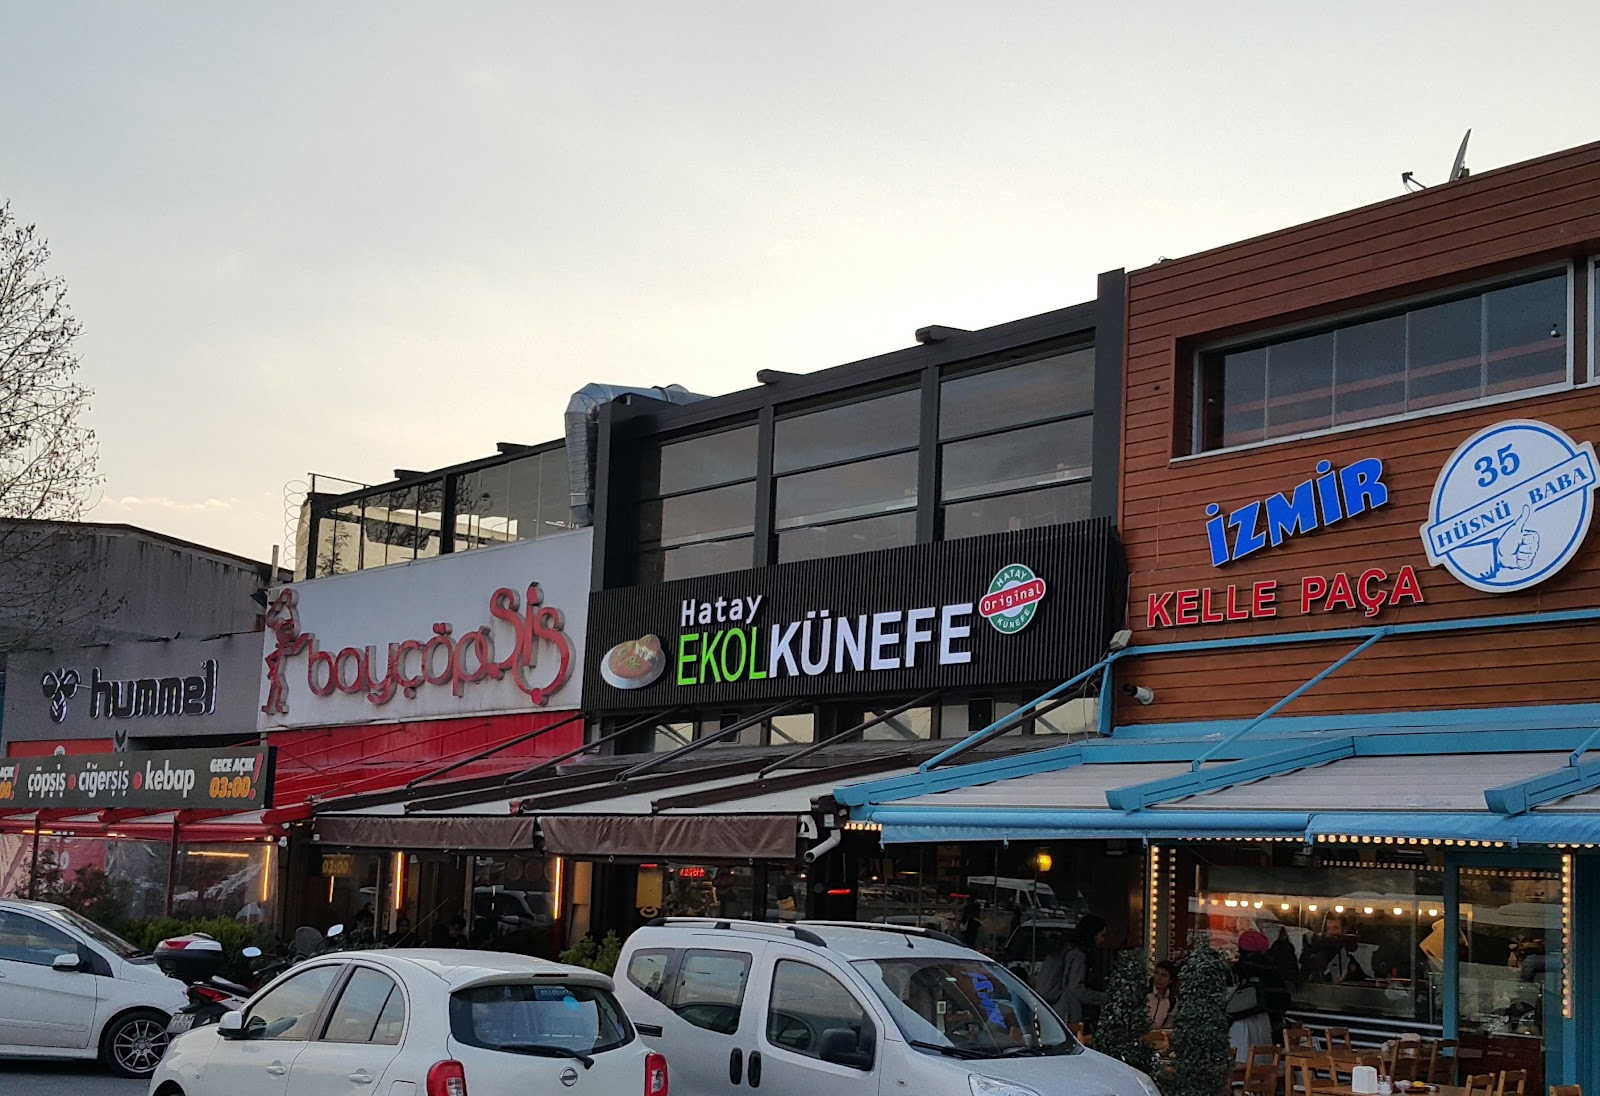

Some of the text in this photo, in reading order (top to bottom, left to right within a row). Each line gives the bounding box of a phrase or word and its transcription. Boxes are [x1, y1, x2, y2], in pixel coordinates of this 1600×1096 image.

[1474, 443, 1520, 488] 35
[1205, 457, 1388, 567] İZMİR
[1436, 467, 1588, 549] HÜSNÜ BABA
[984, 583, 1041, 612] Original
[996, 569, 1027, 587] HATAY
[1147, 565, 1424, 627] KELLE PAÇA
[681, 594, 763, 627] Hatay
[996, 608, 1030, 629] KÜNEFE
[677, 602, 973, 686] EKOL KÜNEFE
[90, 658, 218, 719] hummel
[27, 763, 67, 798] çöpşiş
[144, 759, 195, 798] kebap
[209, 758, 233, 773] GECE
